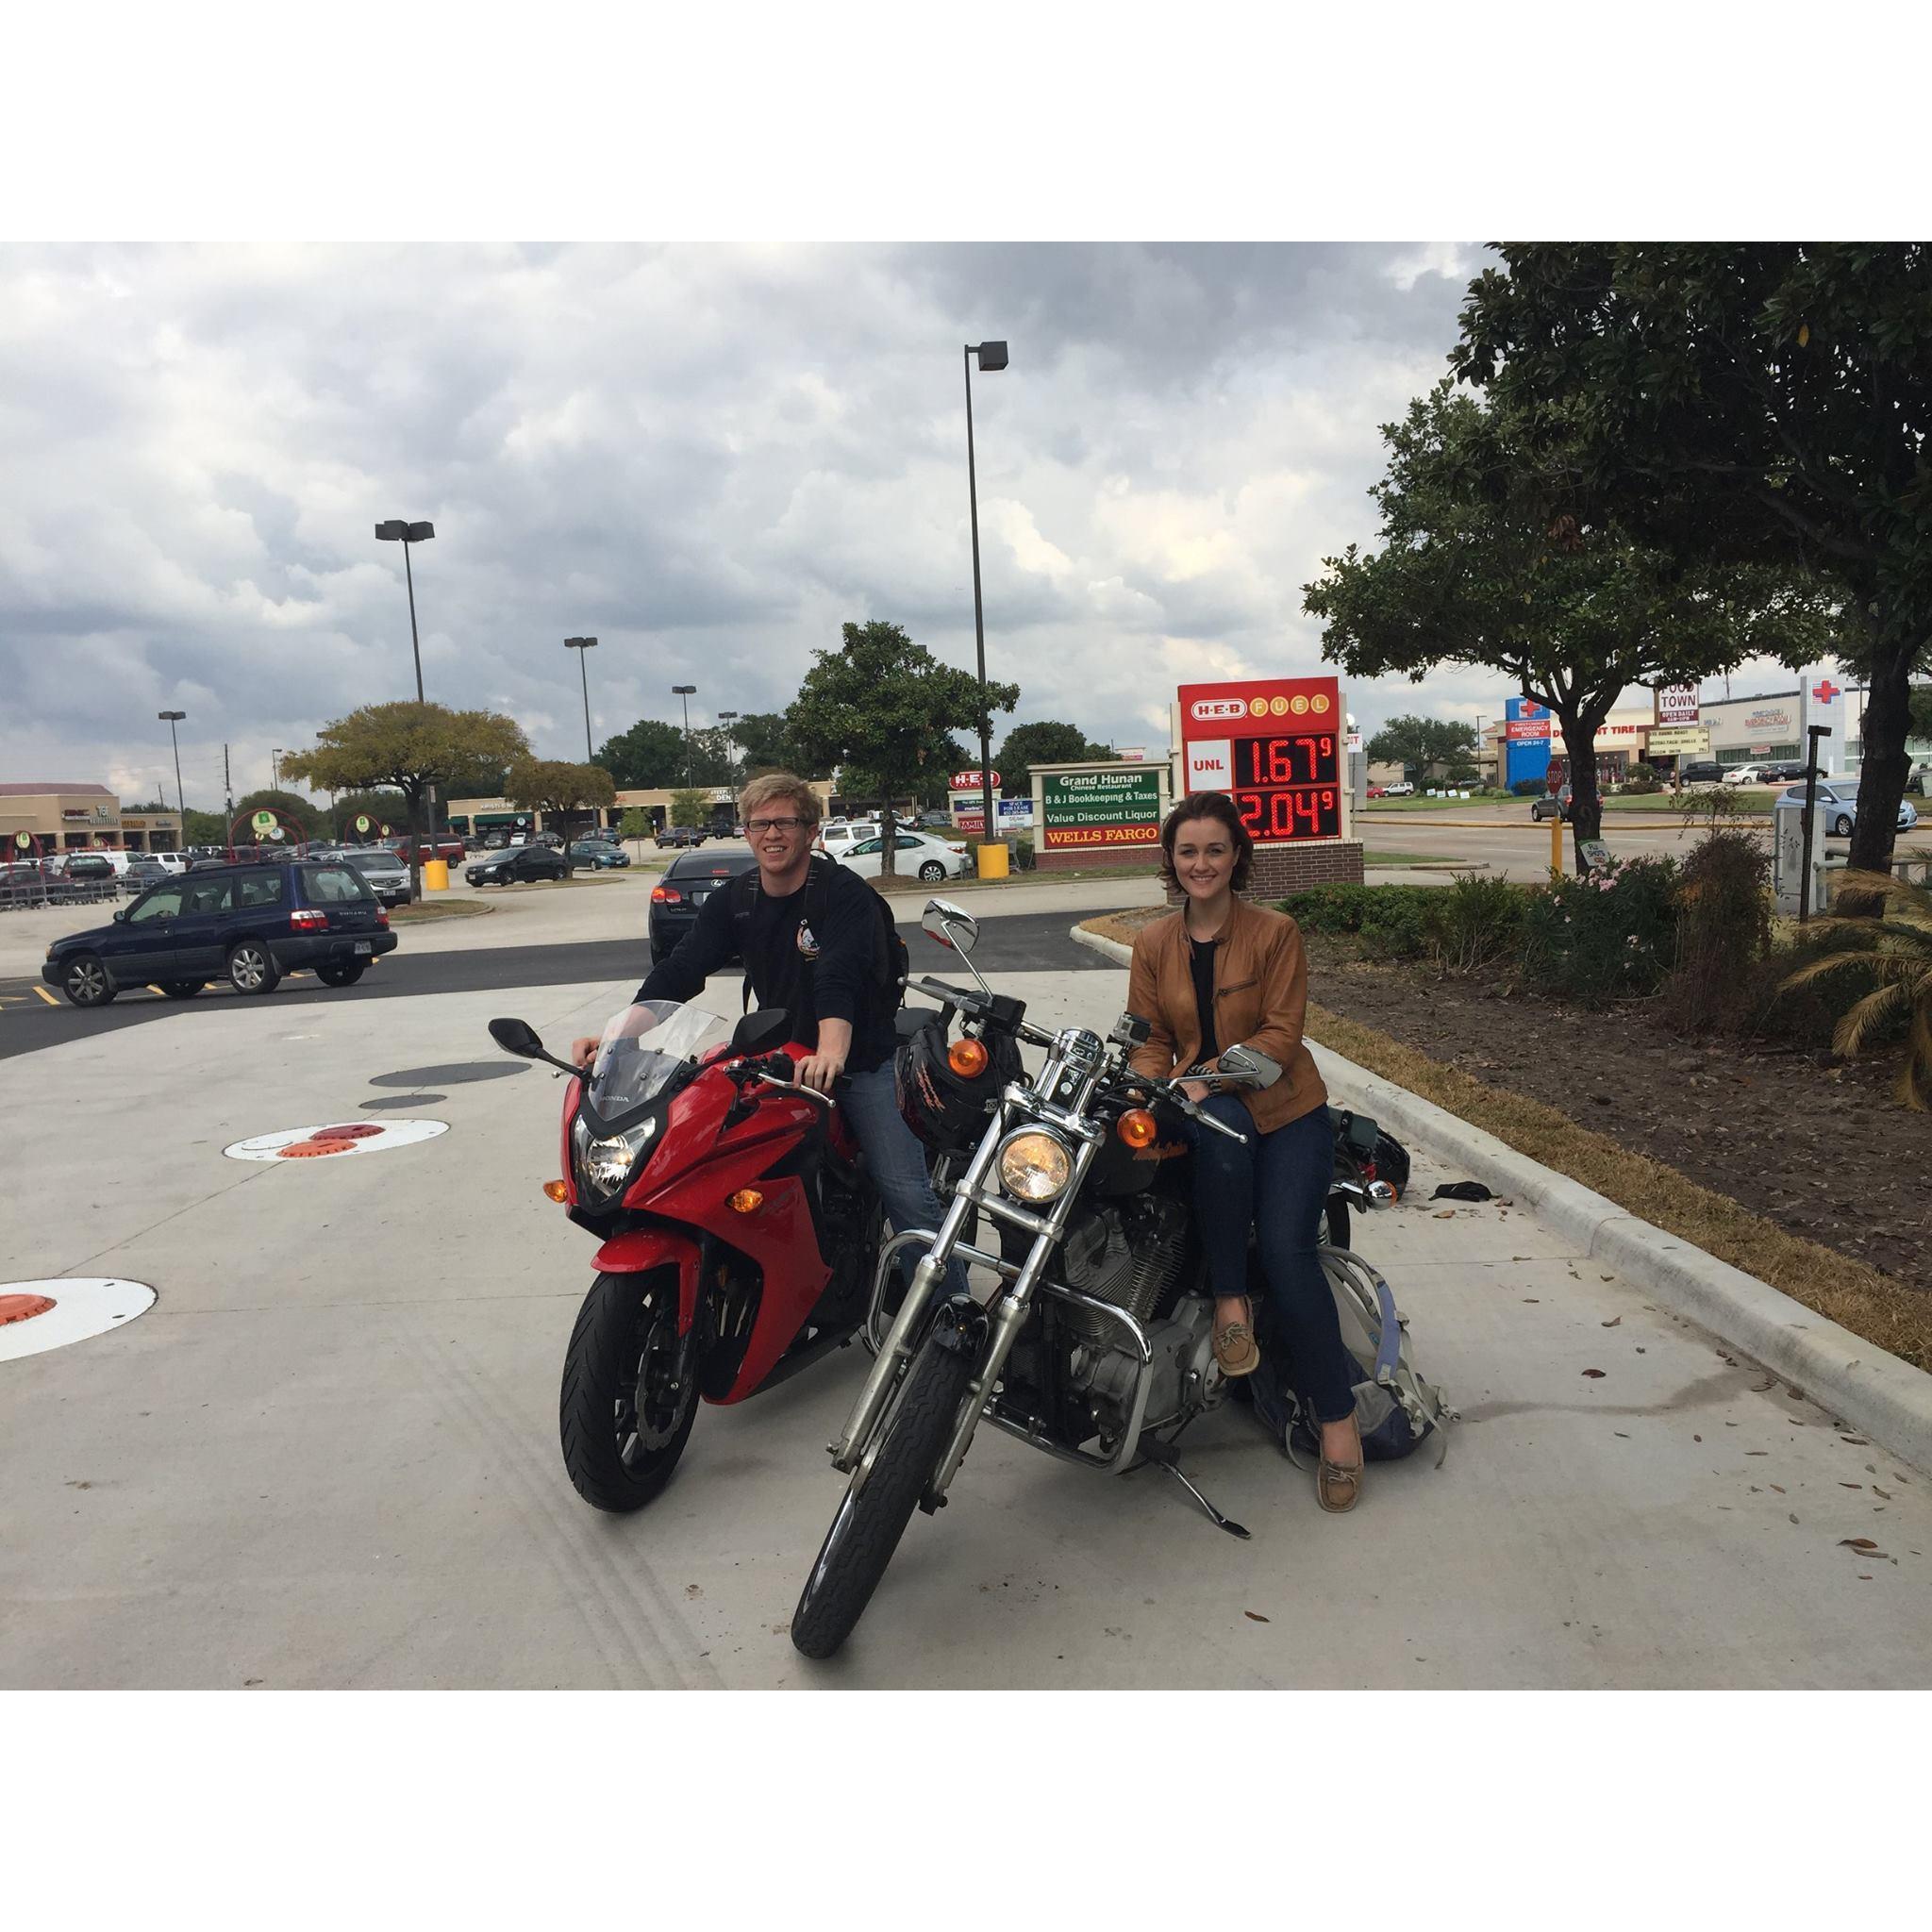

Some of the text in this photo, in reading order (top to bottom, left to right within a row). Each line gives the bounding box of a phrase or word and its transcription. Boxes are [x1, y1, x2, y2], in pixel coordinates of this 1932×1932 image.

[1253, 696, 1325, 714] FUEL
[1661, 694, 1696, 708] TOWN
[1610, 725, 1636, 735] TIRE
[1193, 759, 1224, 772] UNL
[1059, 774, 1142, 787] Grand Hunan
[1547, 770, 1562, 784] STOP
[1045, 795, 1052, 805] B
[1054, 795, 1062, 804] &
[1068, 792, 1124, 804] Bookkeeping
[1125, 792, 1133, 801] &
[1134, 791, 1158, 801] Taxes
[1046, 809, 1158, 824] Value Discount Liquor
[1047, 827, 1158, 843] WELLS FARGO
